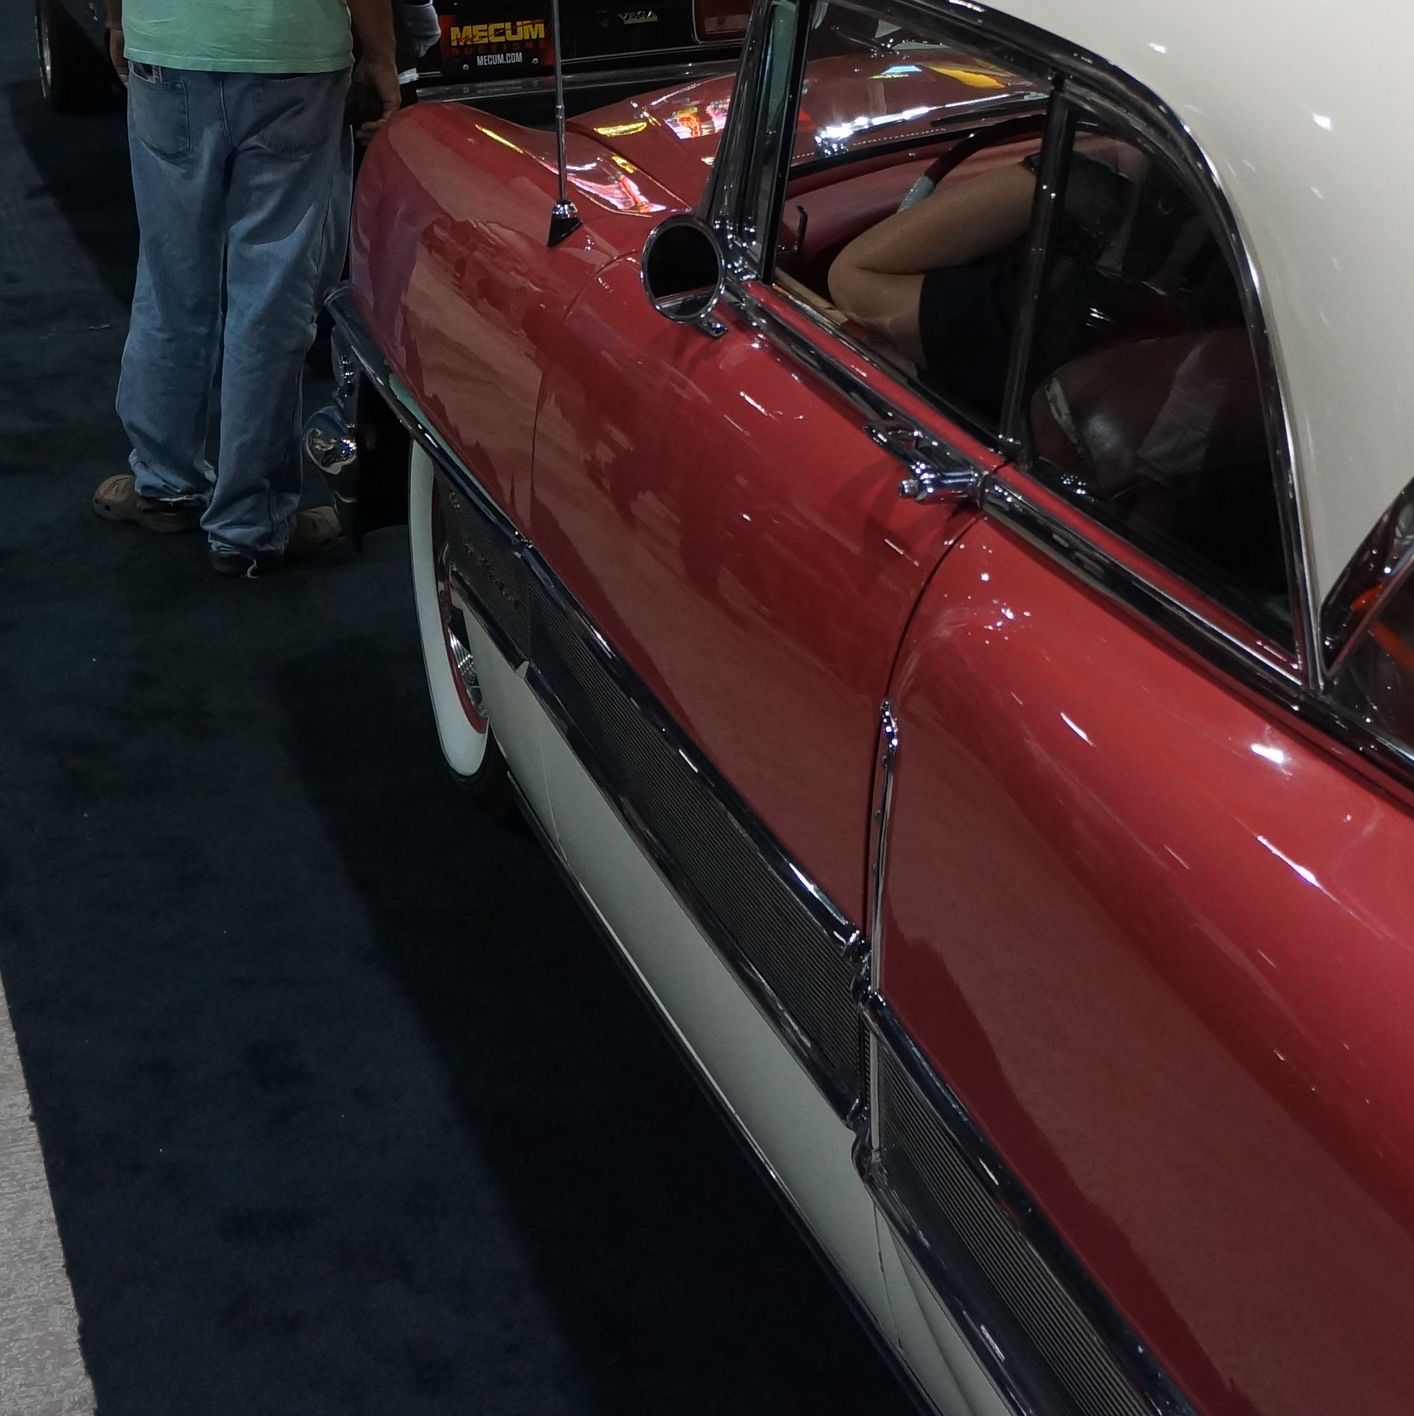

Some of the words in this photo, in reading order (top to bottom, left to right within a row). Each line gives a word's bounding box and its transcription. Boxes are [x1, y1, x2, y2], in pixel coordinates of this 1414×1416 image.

[618, 10, 657, 25] VEGA
[451, 20, 544, 46] MECUM
[477, 52, 523, 67] MECUM.COM
